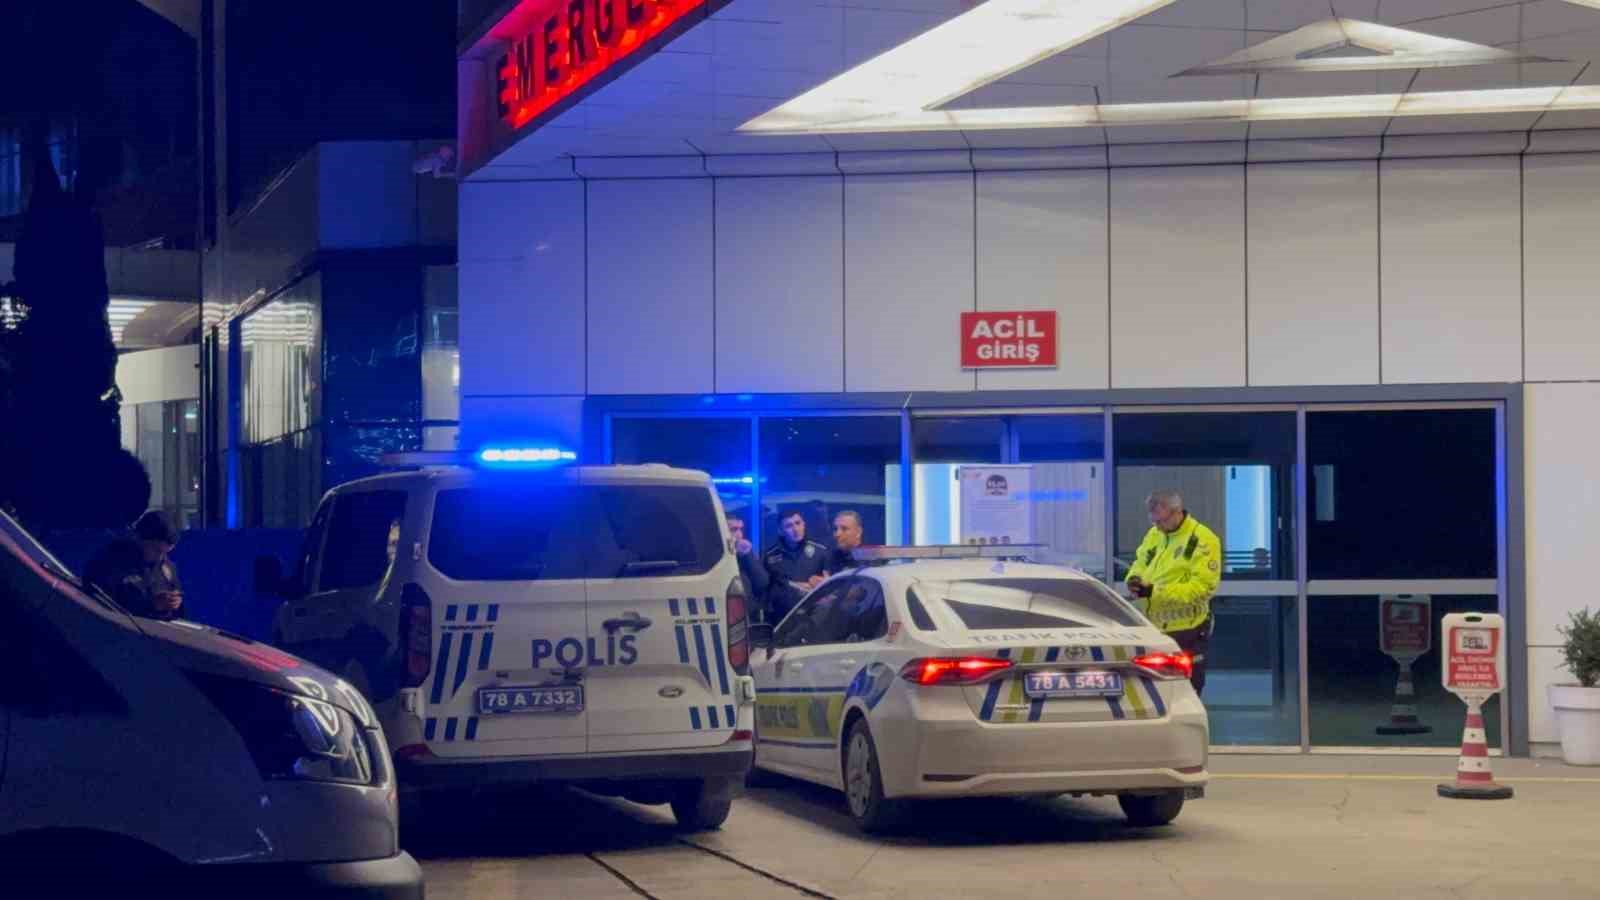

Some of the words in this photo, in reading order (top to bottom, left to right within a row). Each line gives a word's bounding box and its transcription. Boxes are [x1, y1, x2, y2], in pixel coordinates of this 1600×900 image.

[971, 315, 1045, 339] ACİL
[977, 340, 1040, 362] GİRİŞ
[531, 632, 638, 669] POLİS
[1031, 675, 1051, 690] 78
[1057, 675, 1072, 689] A
[1075, 674, 1116, 689] 5431
[486, 693, 508, 706] 78
[513, 692, 528, 706] A
[532, 690, 576, 706] 7332
